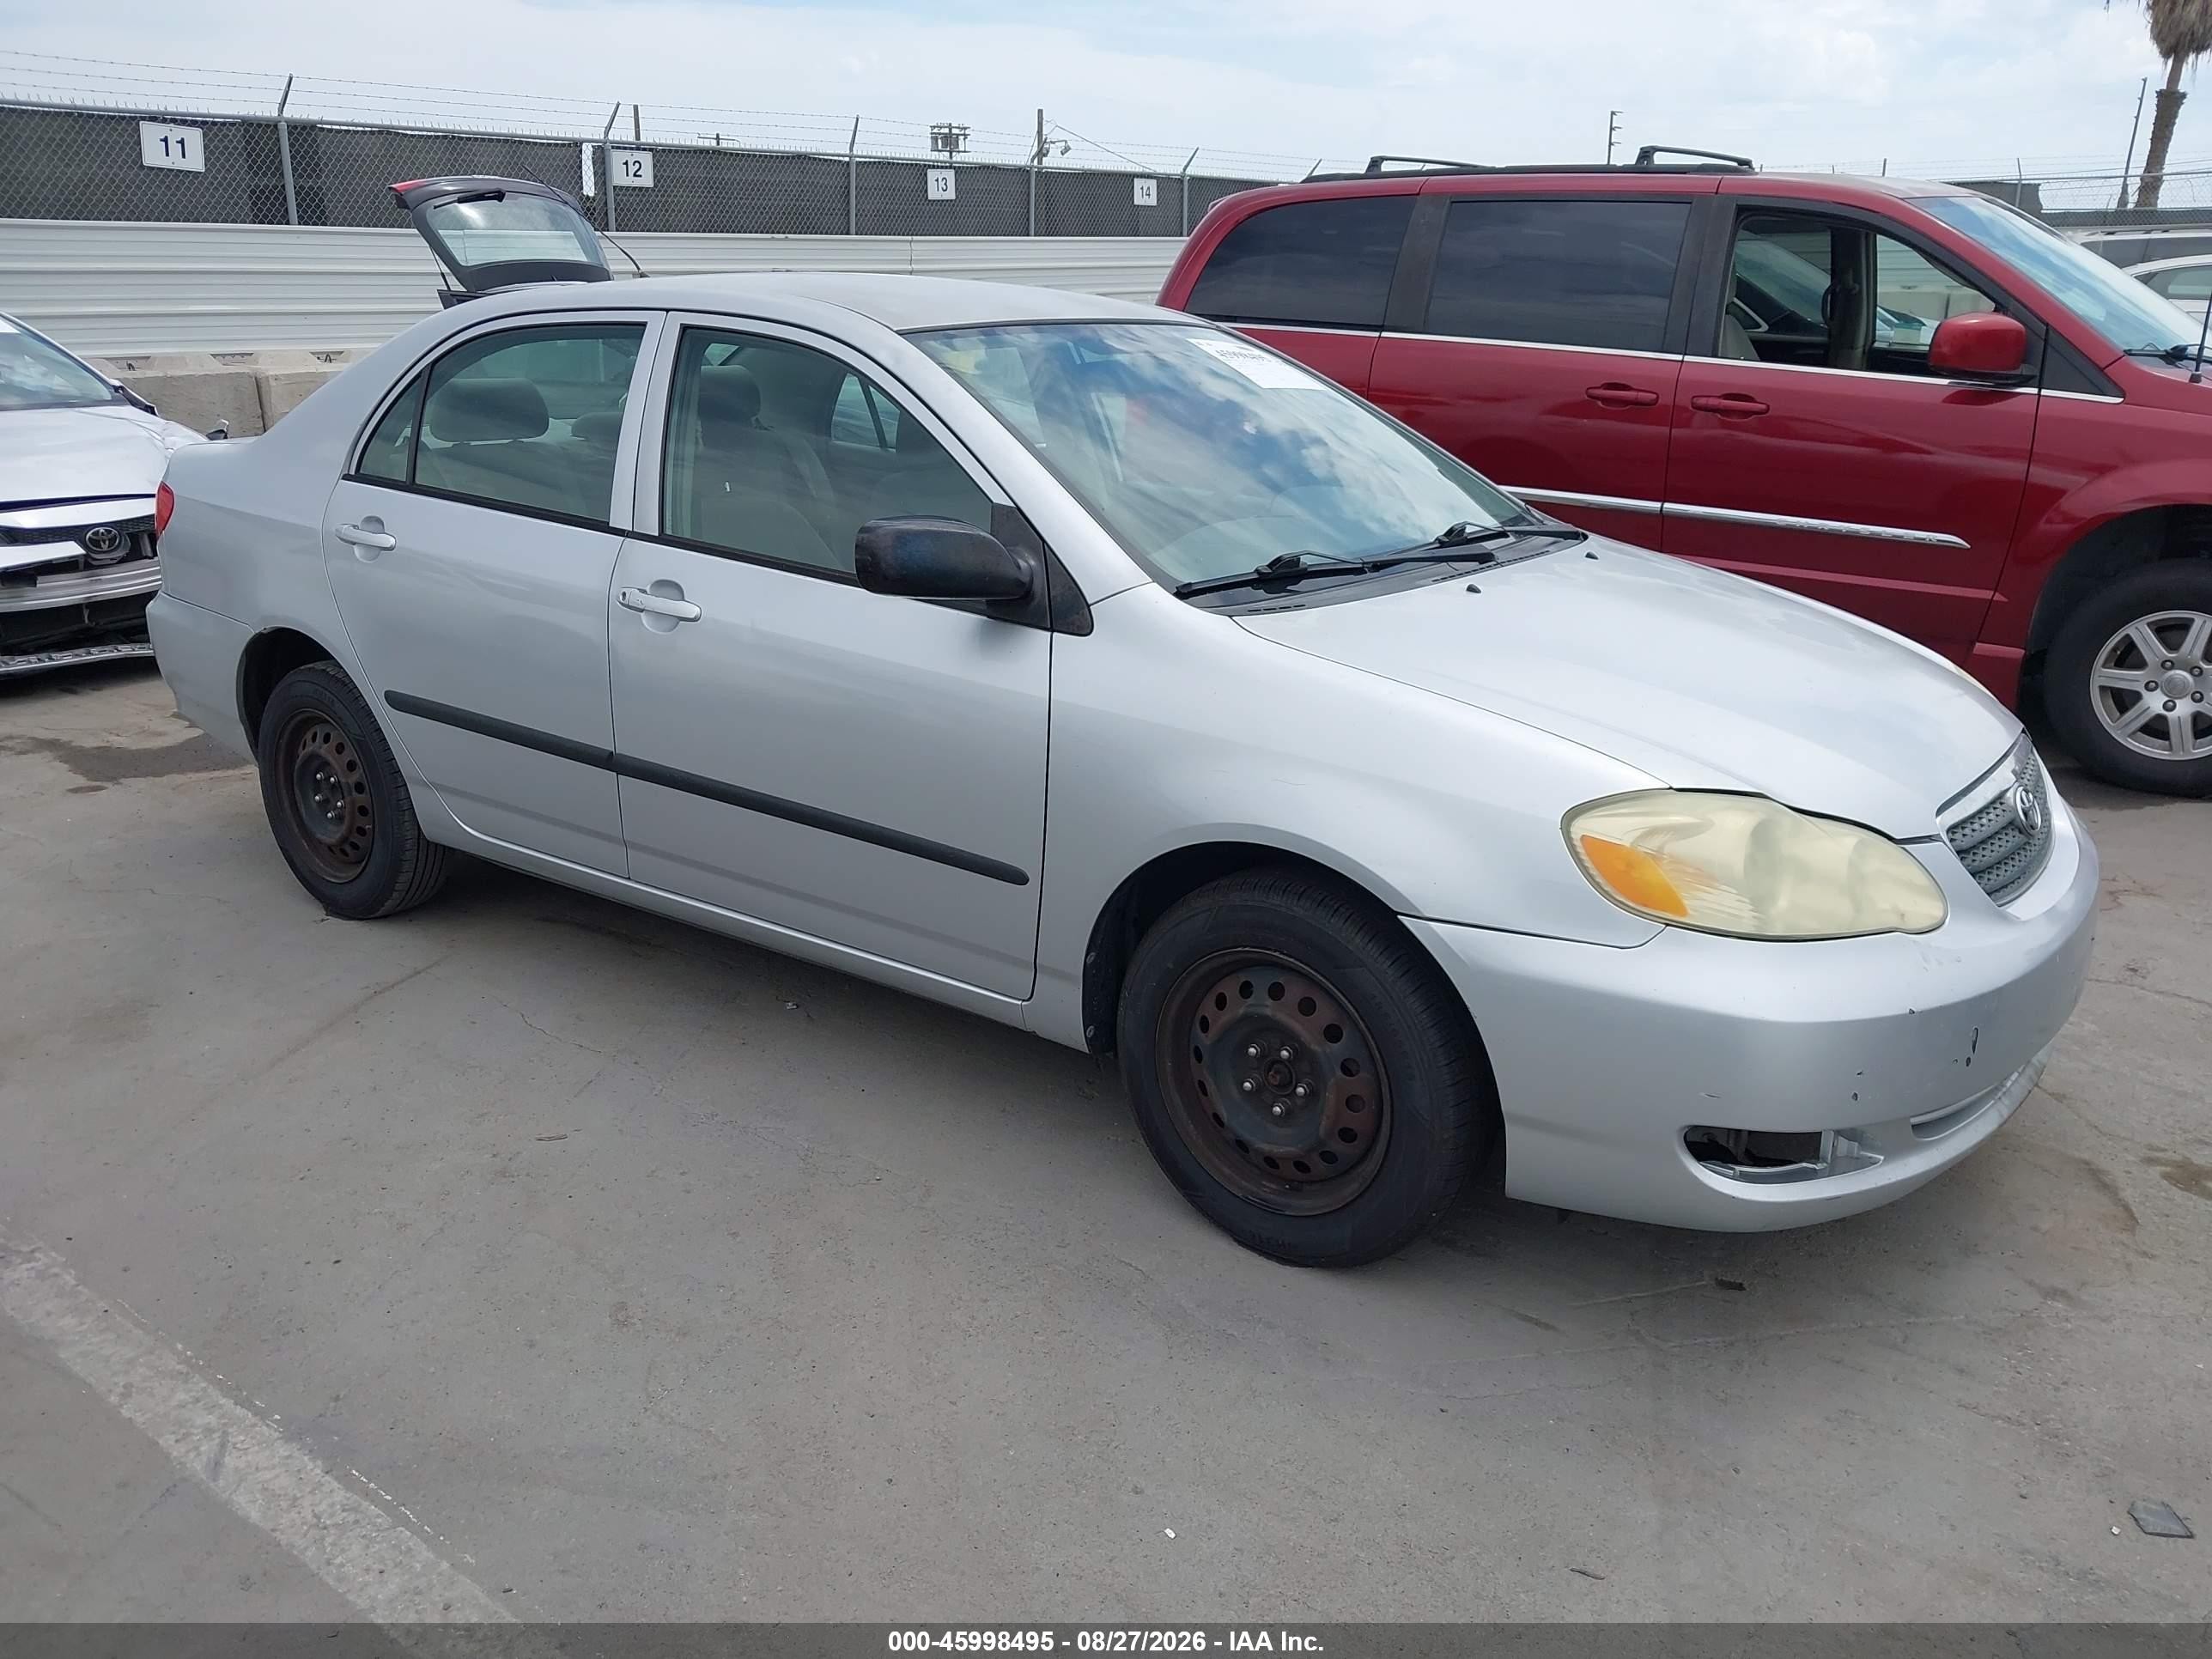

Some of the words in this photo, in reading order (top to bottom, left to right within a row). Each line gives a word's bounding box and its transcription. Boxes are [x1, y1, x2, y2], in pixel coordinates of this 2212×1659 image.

[159, 135, 186, 160] 11
[622, 159, 643, 178] 12
[934, 177, 949, 192] 13
[1139, 185, 1151, 199] 14
